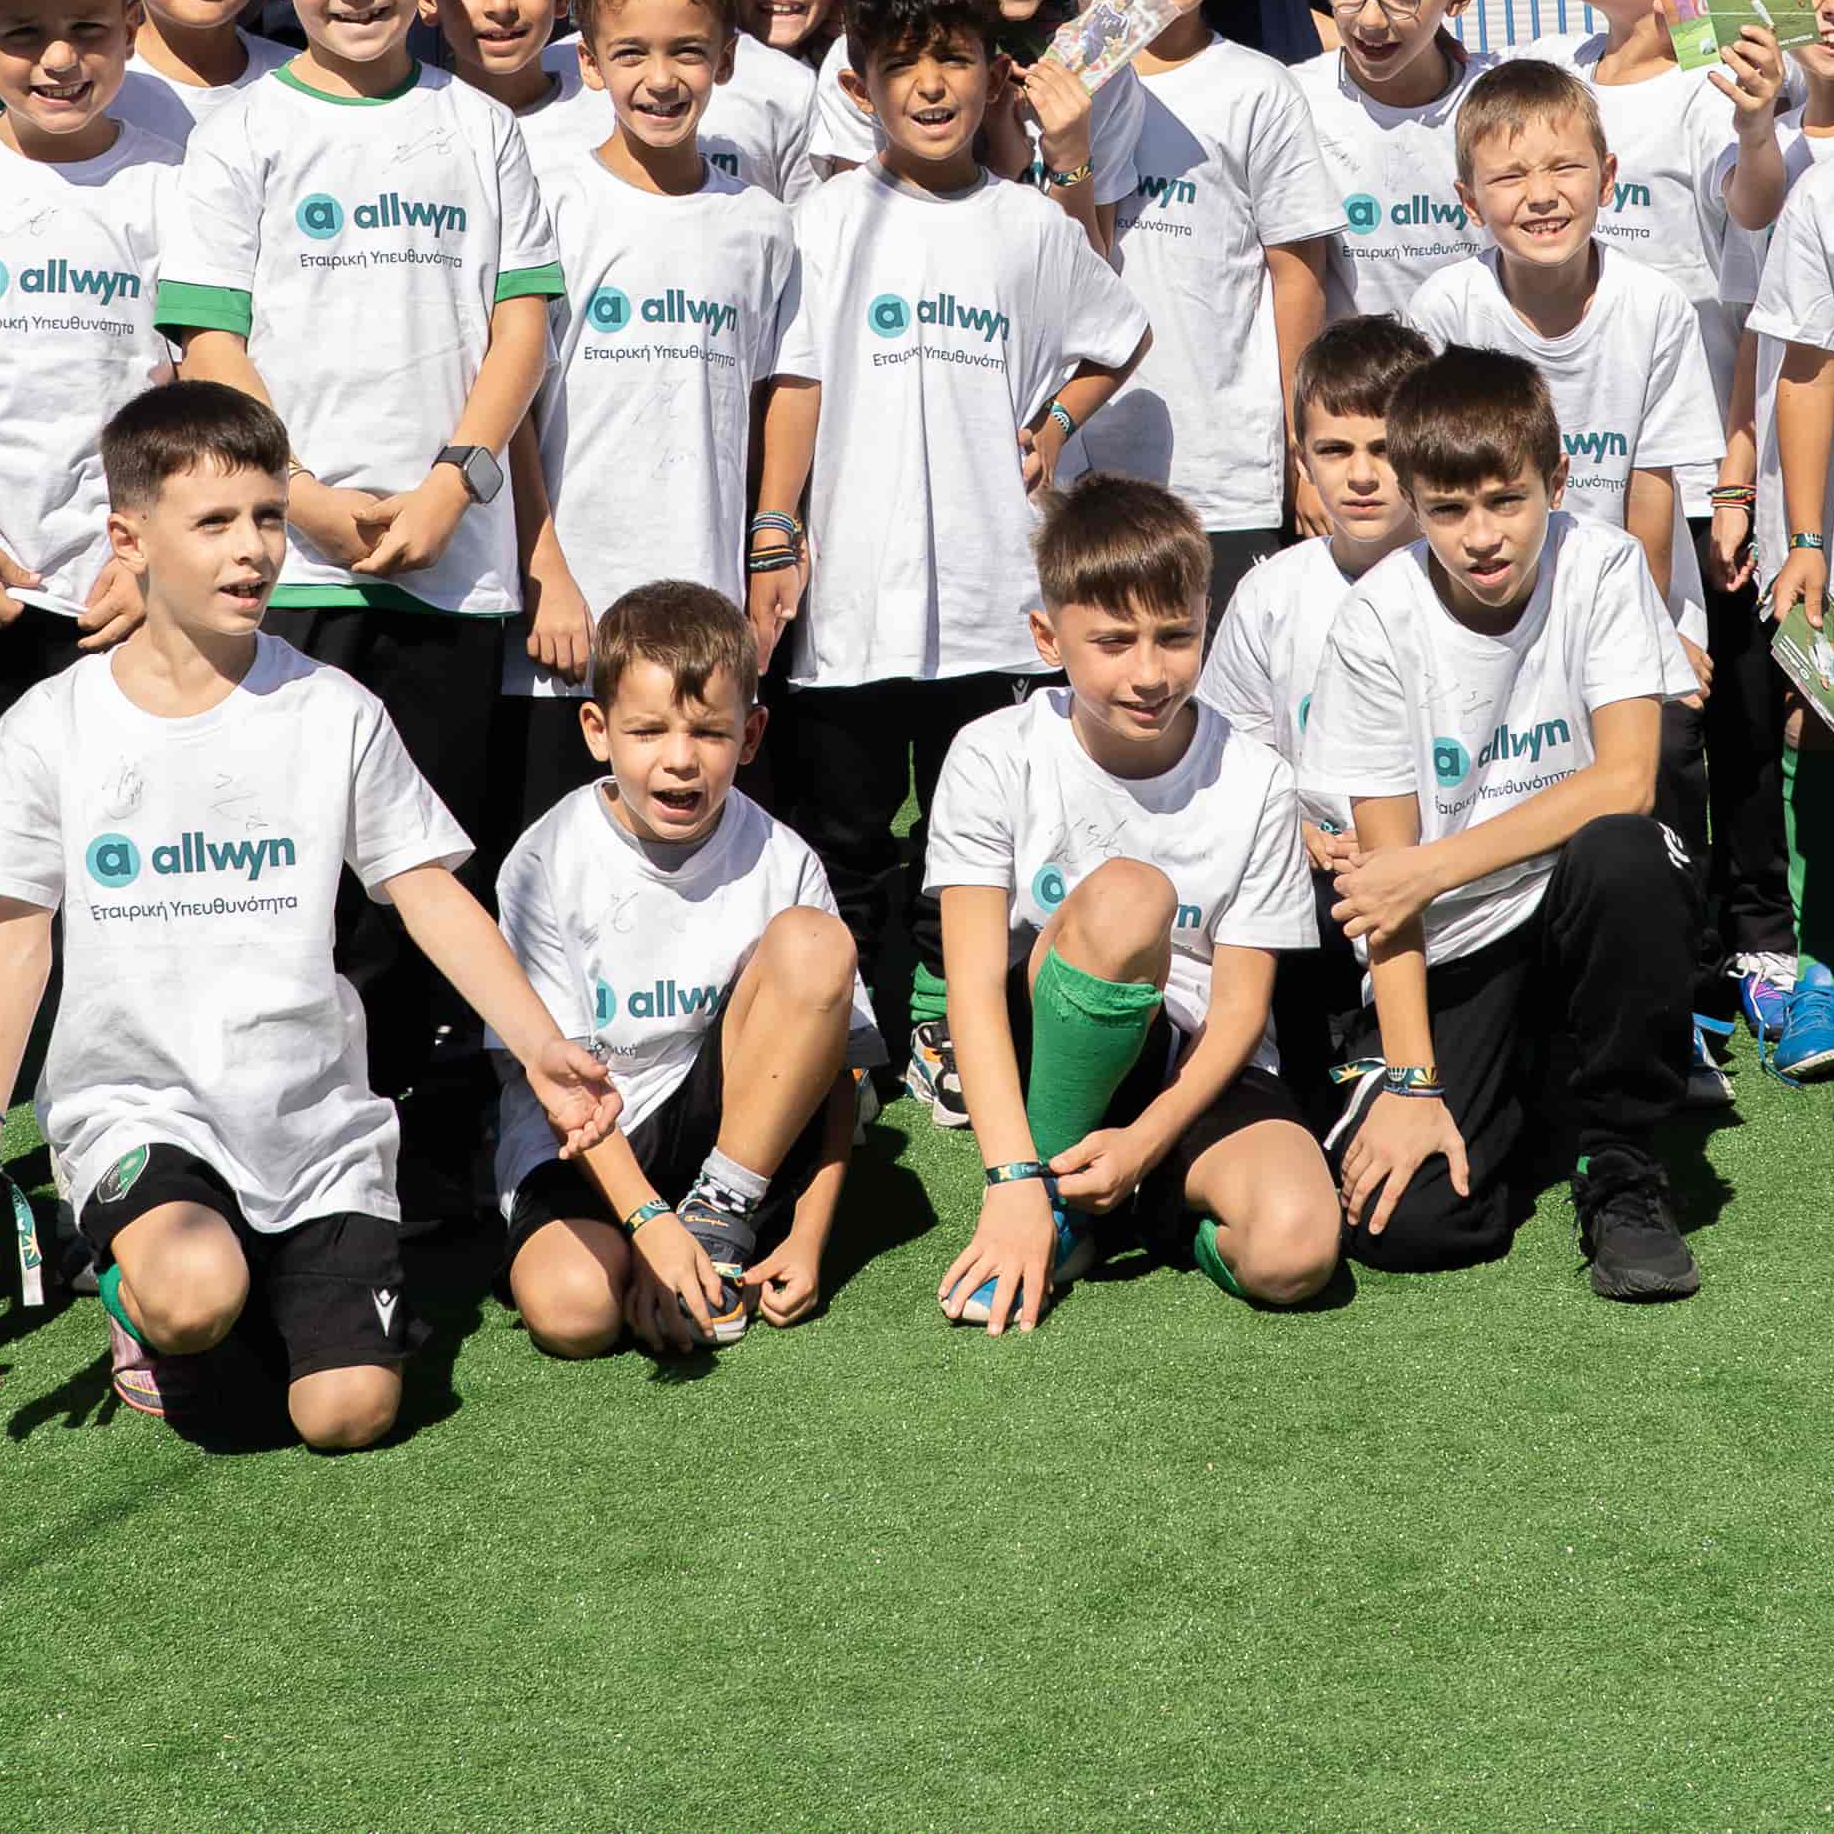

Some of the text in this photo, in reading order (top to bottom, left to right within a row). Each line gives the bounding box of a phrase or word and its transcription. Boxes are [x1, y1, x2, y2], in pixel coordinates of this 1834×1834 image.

[353, 192, 467, 238] allwyn
[1391, 195, 1468, 231] allwy
[300, 252, 367, 270] Εταιρική
[1402, 239, 1481, 257] Υπευθυνότητ
[19, 259, 141, 306] allwyn
[31, 315, 135, 337] Υπευθυνότητα
[641, 288, 738, 336] allwyn
[584, 344, 650, 362] Εταιρική
[923, 345, 1006, 375] Υπευθυνότη
[151, 832, 297, 881] allwyn
[90, 894, 298, 924] Εταιρική Υπευθυνότητα
